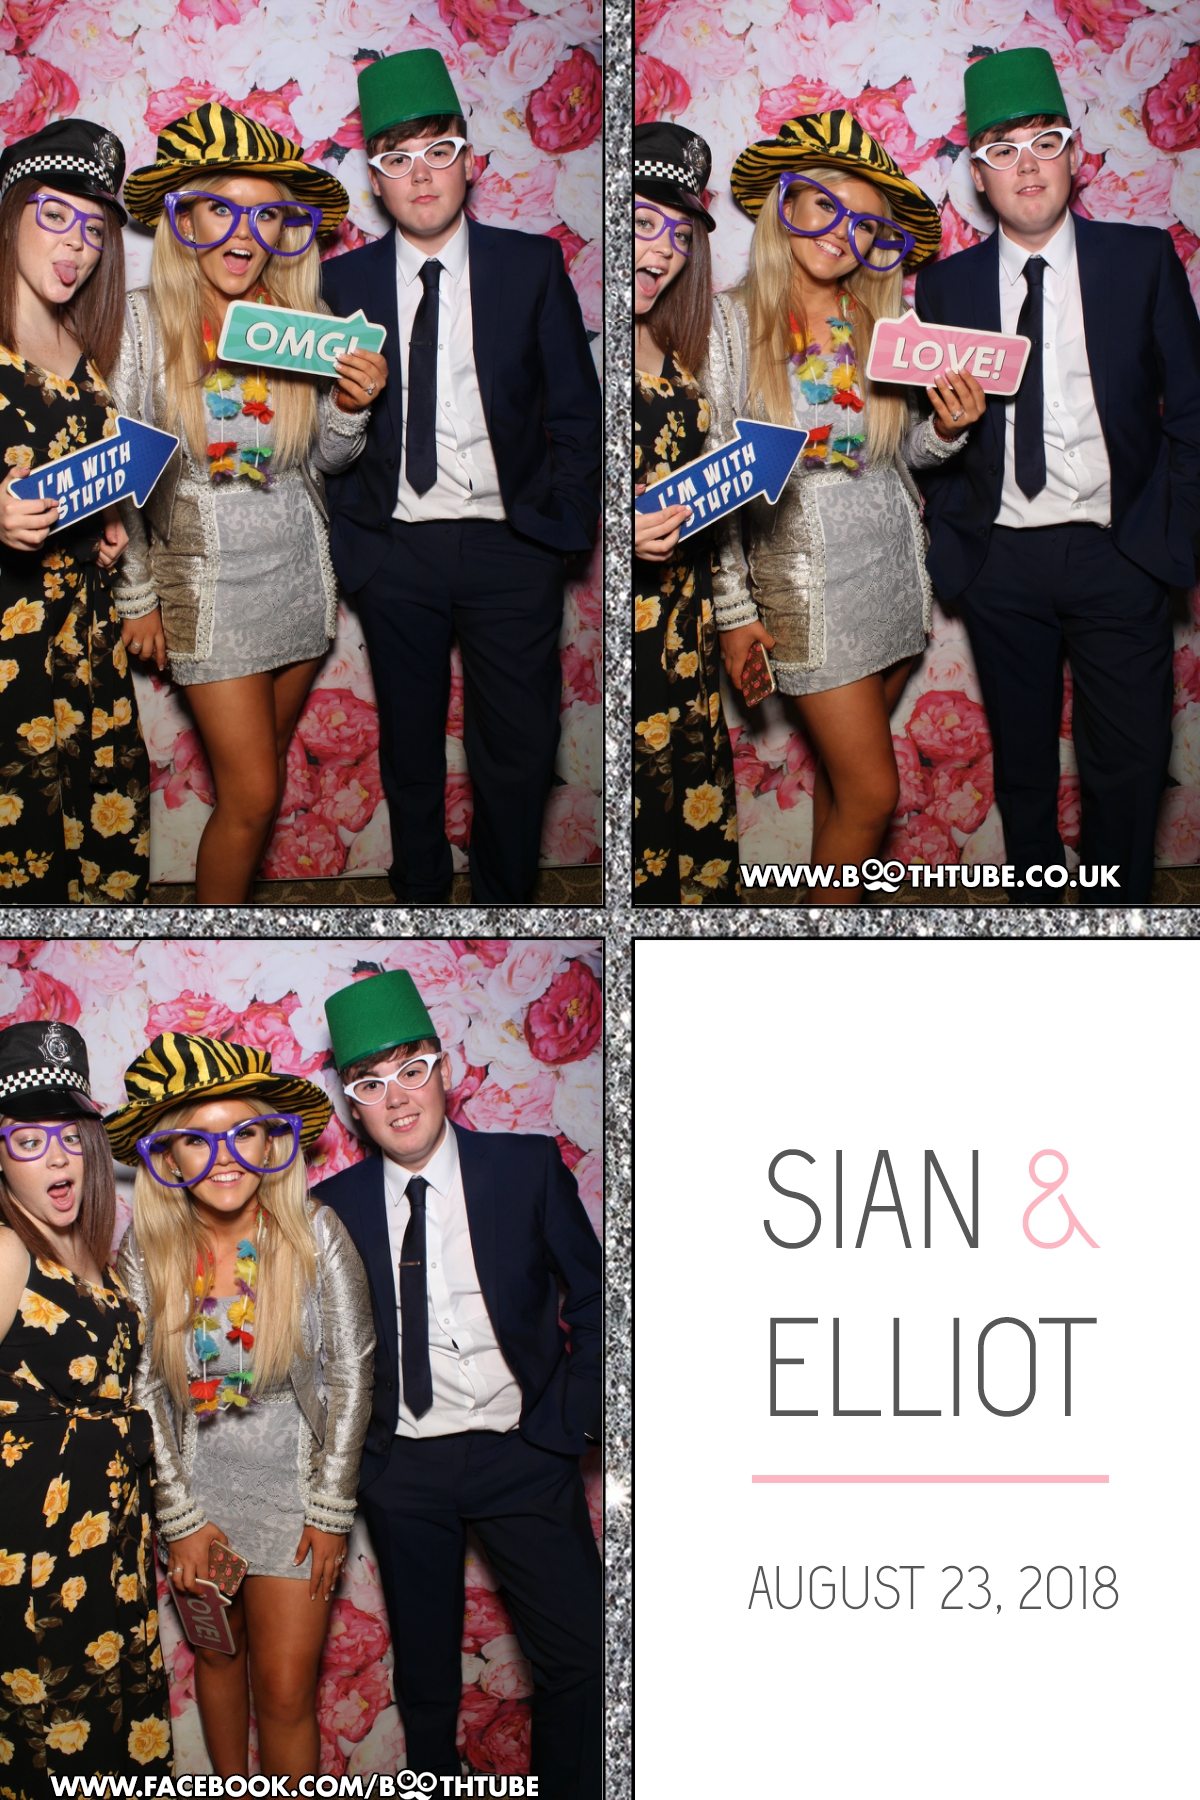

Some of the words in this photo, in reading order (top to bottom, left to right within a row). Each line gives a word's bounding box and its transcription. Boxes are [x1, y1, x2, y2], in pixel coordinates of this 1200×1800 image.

[892, 336, 1007, 381] LOVE!
[37, 466, 75, 501] I'M
[81, 440, 132, 482] WITH
[57, 468, 127, 521] STUPID
[657, 476, 698, 511] I'M
[702, 442, 757, 489] WITH
[186, 1594, 222, 1644] OVE!
